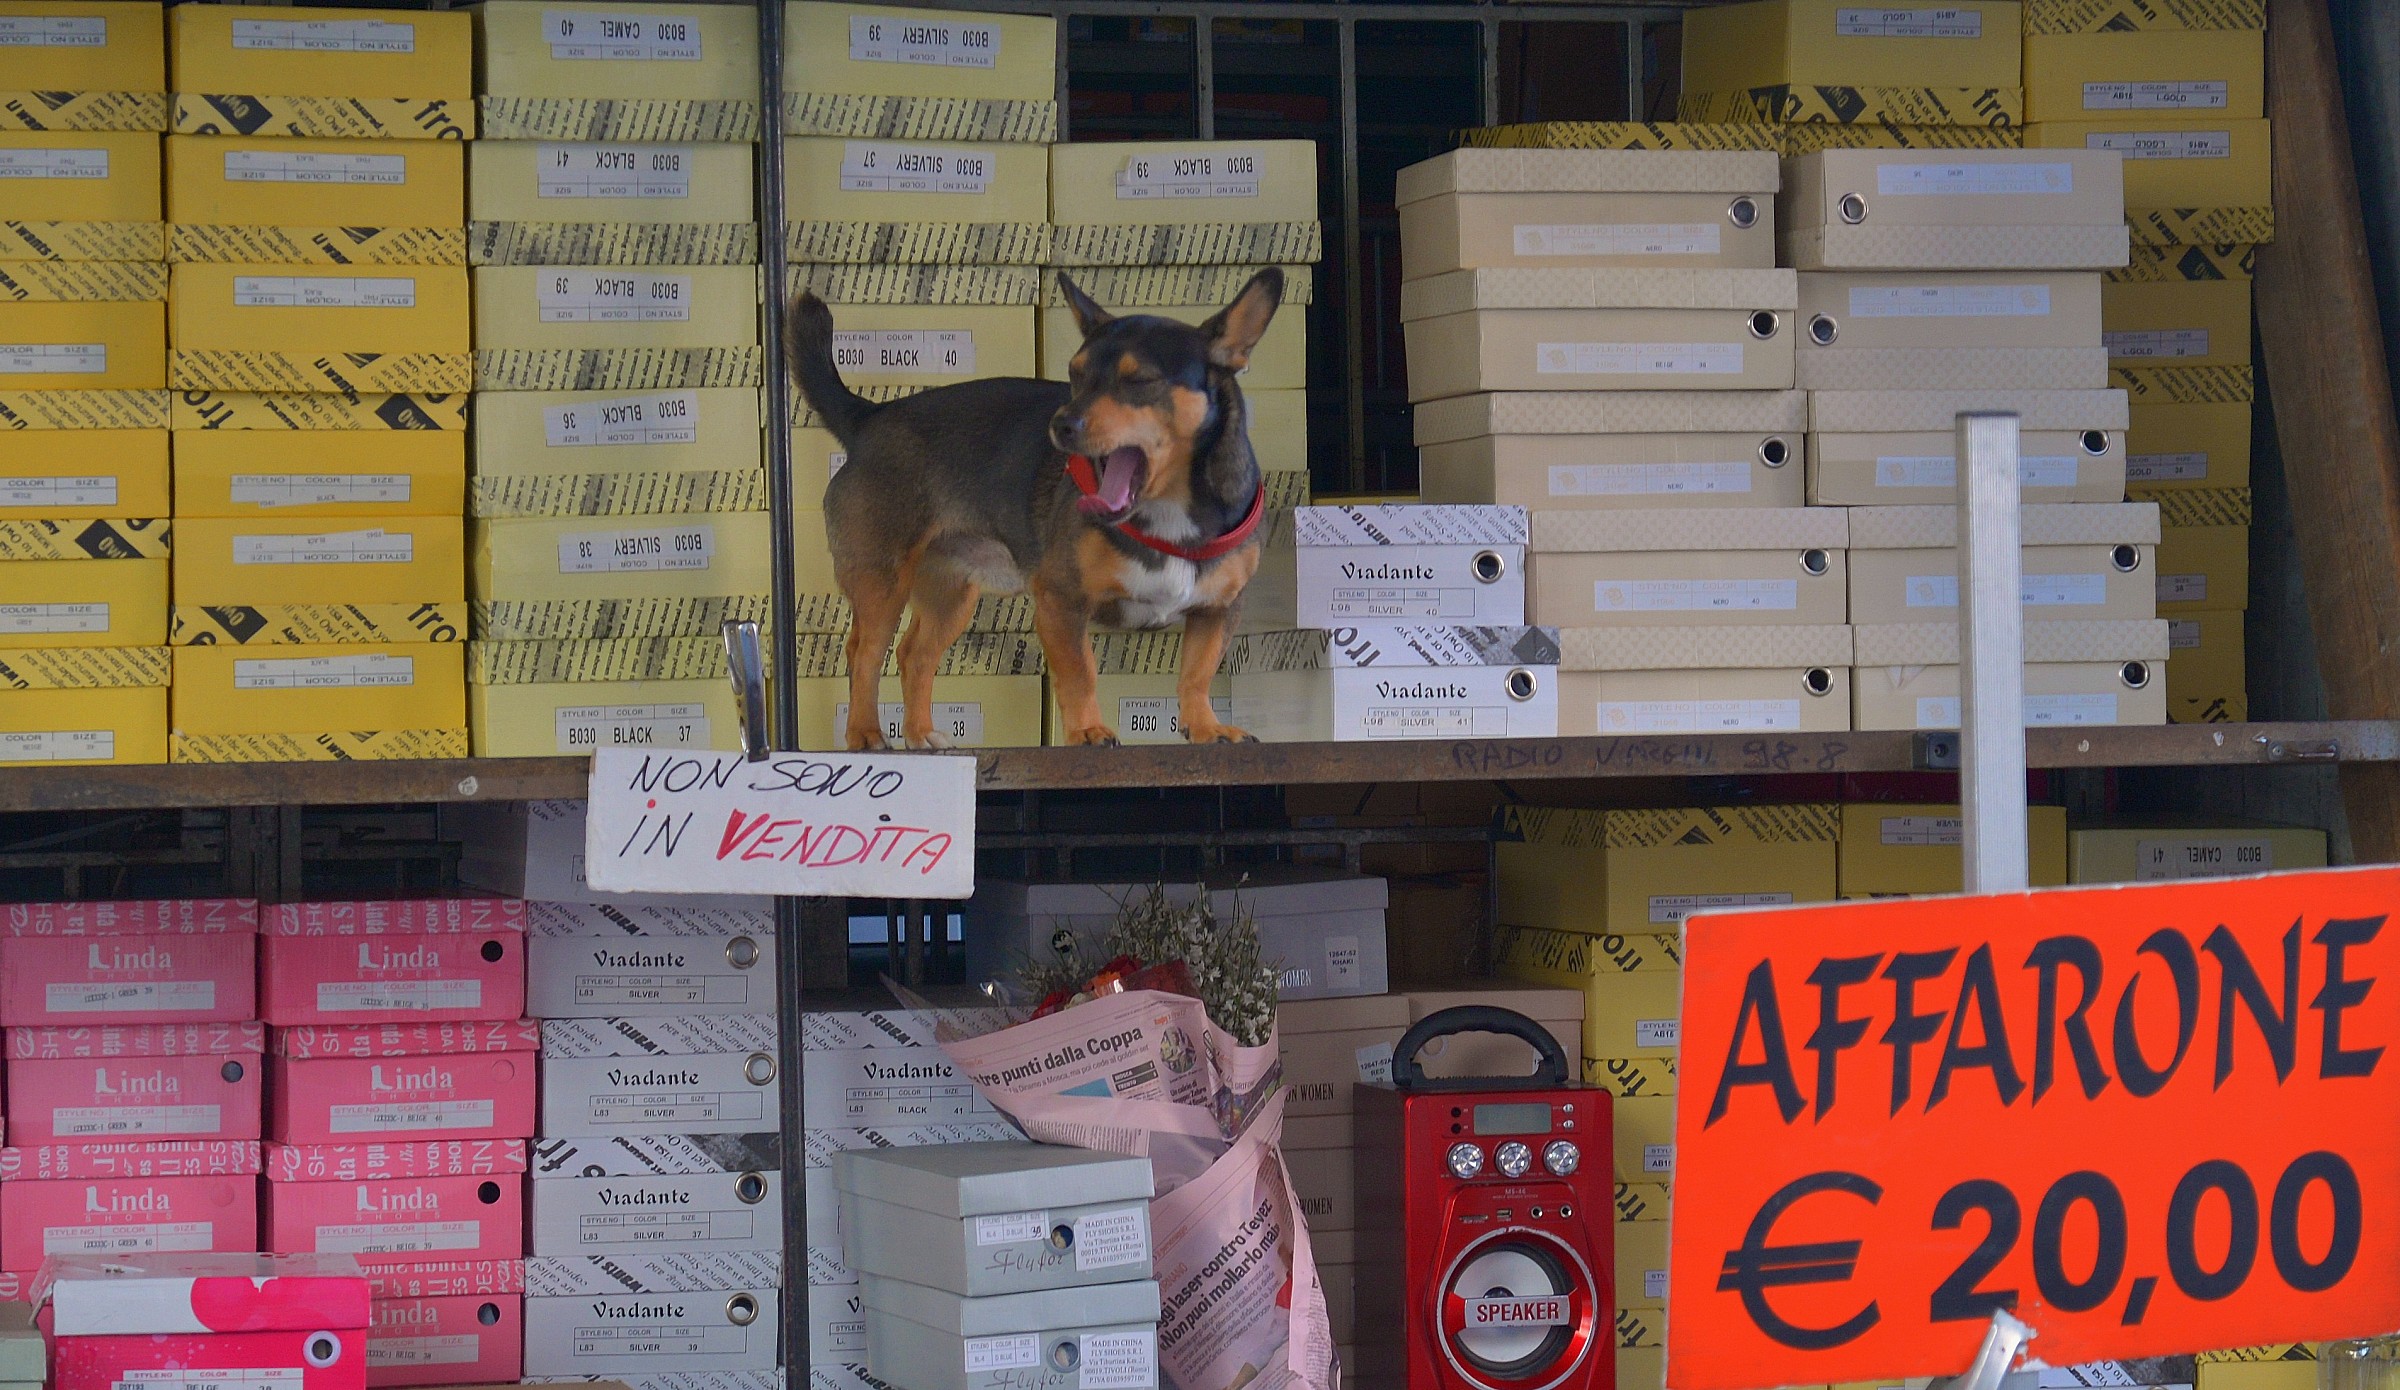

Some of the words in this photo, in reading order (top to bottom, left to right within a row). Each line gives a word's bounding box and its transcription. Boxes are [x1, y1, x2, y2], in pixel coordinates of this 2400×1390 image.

[561, 20, 573, 36] 40
[600, 21, 640, 39] CAMEL
[659, 24, 686, 41] B030
[869, 25, 881, 42] 39
[902, 26, 948, 44] SILVERY
[963, 30, 988, 47] B030
[557, 150, 568, 167] 41
[596, 152, 635, 169] BLACK
[653, 154, 679, 171] B030
[864, 151, 875, 167] 37
[896, 154, 943, 172] SILVERY
[1174, 158, 1211, 176] BLACK
[1228, 157, 1253, 173] B030
[957, 159, 982, 176] B030
[1137, 162, 1149, 178] 39
[556, 277, 568, 294] 39
[595, 278, 634, 297] BLACK
[652, 282, 678, 299] B030
[838, 349, 864, 365] B030
[881, 350, 919, 367] BLACK
[945, 350, 957, 366] 40
[602, 404, 642, 424] BLACK
[659, 400, 686, 418] B030
[563, 412, 575, 429] 36
[579, 541, 591, 558] 38
[614, 537, 661, 556] SILVERY
[675, 534, 702, 551] B030
[1341, 562, 1434, 580] Viadante
[1368, 606, 1403, 614] SILVER
[1376, 681, 1467, 699] Viadante
[562, 710, 585, 718] STYLE
[616, 708, 643, 716] COLOR
[671, 707, 687, 715] SIZE
[953, 720, 965, 737] 38
[1131, 715, 1157, 732] B030
[1401, 718, 1434, 726] SILVER
[570, 728, 596, 743] B030
[614, 727, 652, 743] BLACK
[679, 725, 690, 742] 37
[1452, 742, 1563, 772] RADIO
[629, 754, 744, 792] NON
[2154, 848, 2163, 862] 41
[2187, 847, 2221, 862] CAMEL
[2237, 847, 2261, 862] B030
[88, 944, 171, 970] Linda
[358, 943, 440, 969] Linda
[593, 950, 685, 967] Viadante
[629, 991, 659, 999] SILVER
[1703, 914, 2390, 1133] AFFARONE
[981, 1073, 1001, 1088] tre
[1000, 1057, 1042, 1083] punti
[1044, 1046, 1085, 1070] dalla
[1086, 1026, 1144, 1054] Coppa
[371, 1065, 453, 1091] Linda
[607, 1068, 699, 1086] Viadante
[864, 1062, 952, 1079] Viadante
[95, 1068, 179, 1094] Linda
[1301, 1084, 1334, 1100] WOMEN
[644, 1109, 675, 1117] SILVER
[85, 1185, 170, 1212] Linda
[356, 1185, 439, 1211] Linda
[598, 1189, 690, 1206] Viadante
[1085, 1221, 1105, 1229] MADE
[1114, 1216, 1134, 1224] CHINA
[1715, 1171, 1884, 1352] €
[1929, 1150, 2362, 1327] 20,00
[1171, 1271, 1202, 1306] laser
[1201, 1235, 1247, 1278] contro
[370, 1300, 438, 1326] inda
[593, 1301, 685, 1318] Viadante
[1184, 1295, 1214, 1329] puoi
[1477, 1302, 1559, 1322] SPEAKER
